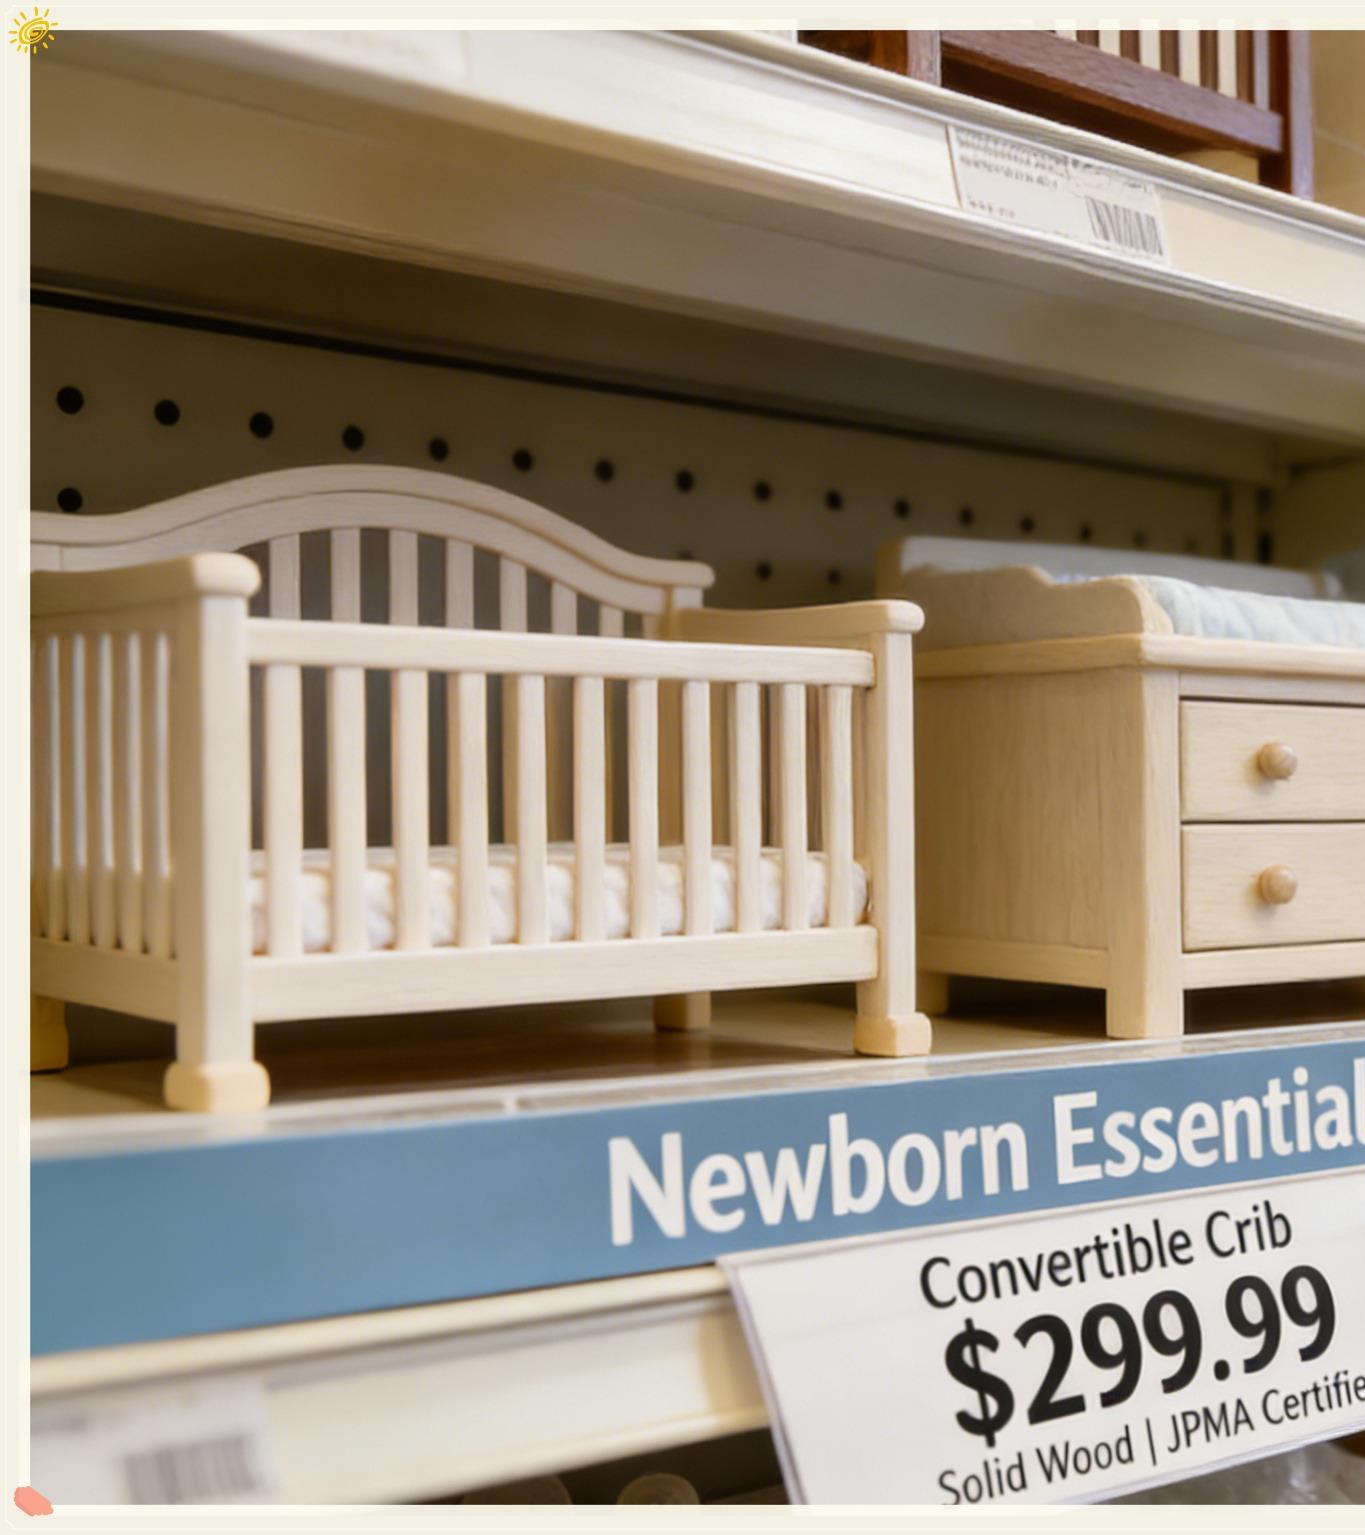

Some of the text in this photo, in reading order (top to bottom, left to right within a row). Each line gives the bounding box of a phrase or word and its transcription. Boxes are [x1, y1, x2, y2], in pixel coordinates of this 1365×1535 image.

[607, 1112, 1030, 1246] Newborn
[919, 1200, 1293, 1309] Convertible Crib
[943, 1264, 1337, 1448] $299.99
[937, 1451, 1028, 1505] Solid
[1034, 1424, 1135, 1484] Wood
[1166, 1397, 1256, 1454] JPMA
